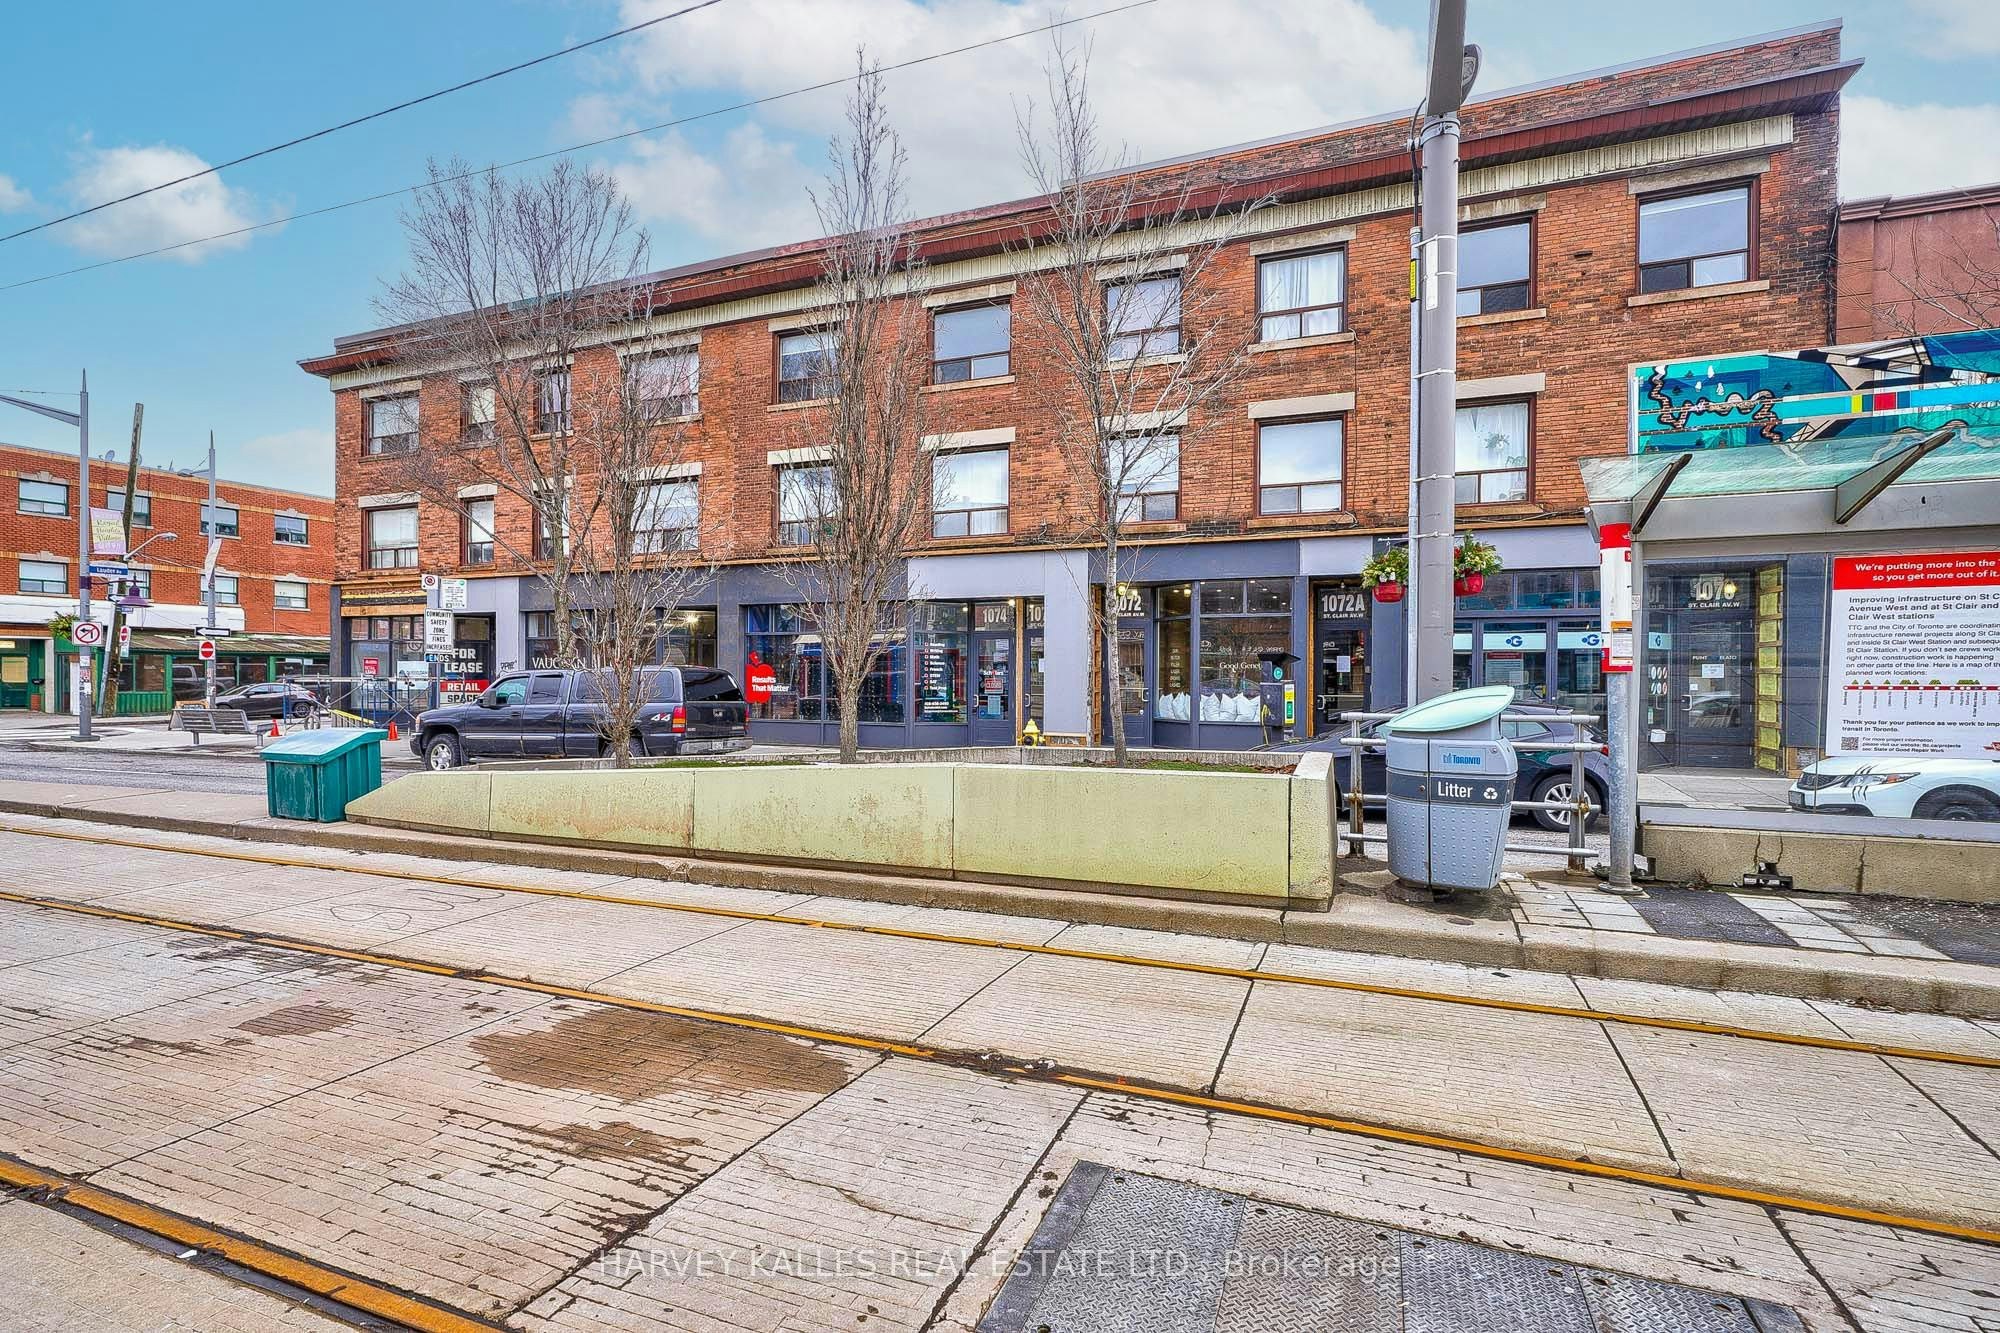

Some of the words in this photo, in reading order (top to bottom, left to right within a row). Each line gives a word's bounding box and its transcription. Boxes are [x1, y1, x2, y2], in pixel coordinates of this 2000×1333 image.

[1856, 563, 1884, 571] We're
[1886, 562, 1924, 572] putting
[1907, 573, 1924, 582] get
[1976, 570, 1988, 578] of
[1115, 596, 1142, 611] 072
[1322, 594, 1366, 612] 1072A
[426, 610, 452, 618] COMMUNITY
[982, 608, 1007, 623] 1074
[452, 648, 476, 660] FOR
[444, 662, 484, 673] LEASE
[447, 682, 480, 691] RETAIL
[448, 694, 478, 703] SPACE
[1453, 754, 1480, 764] TORONTO
[1438, 781, 1474, 798] Litter
